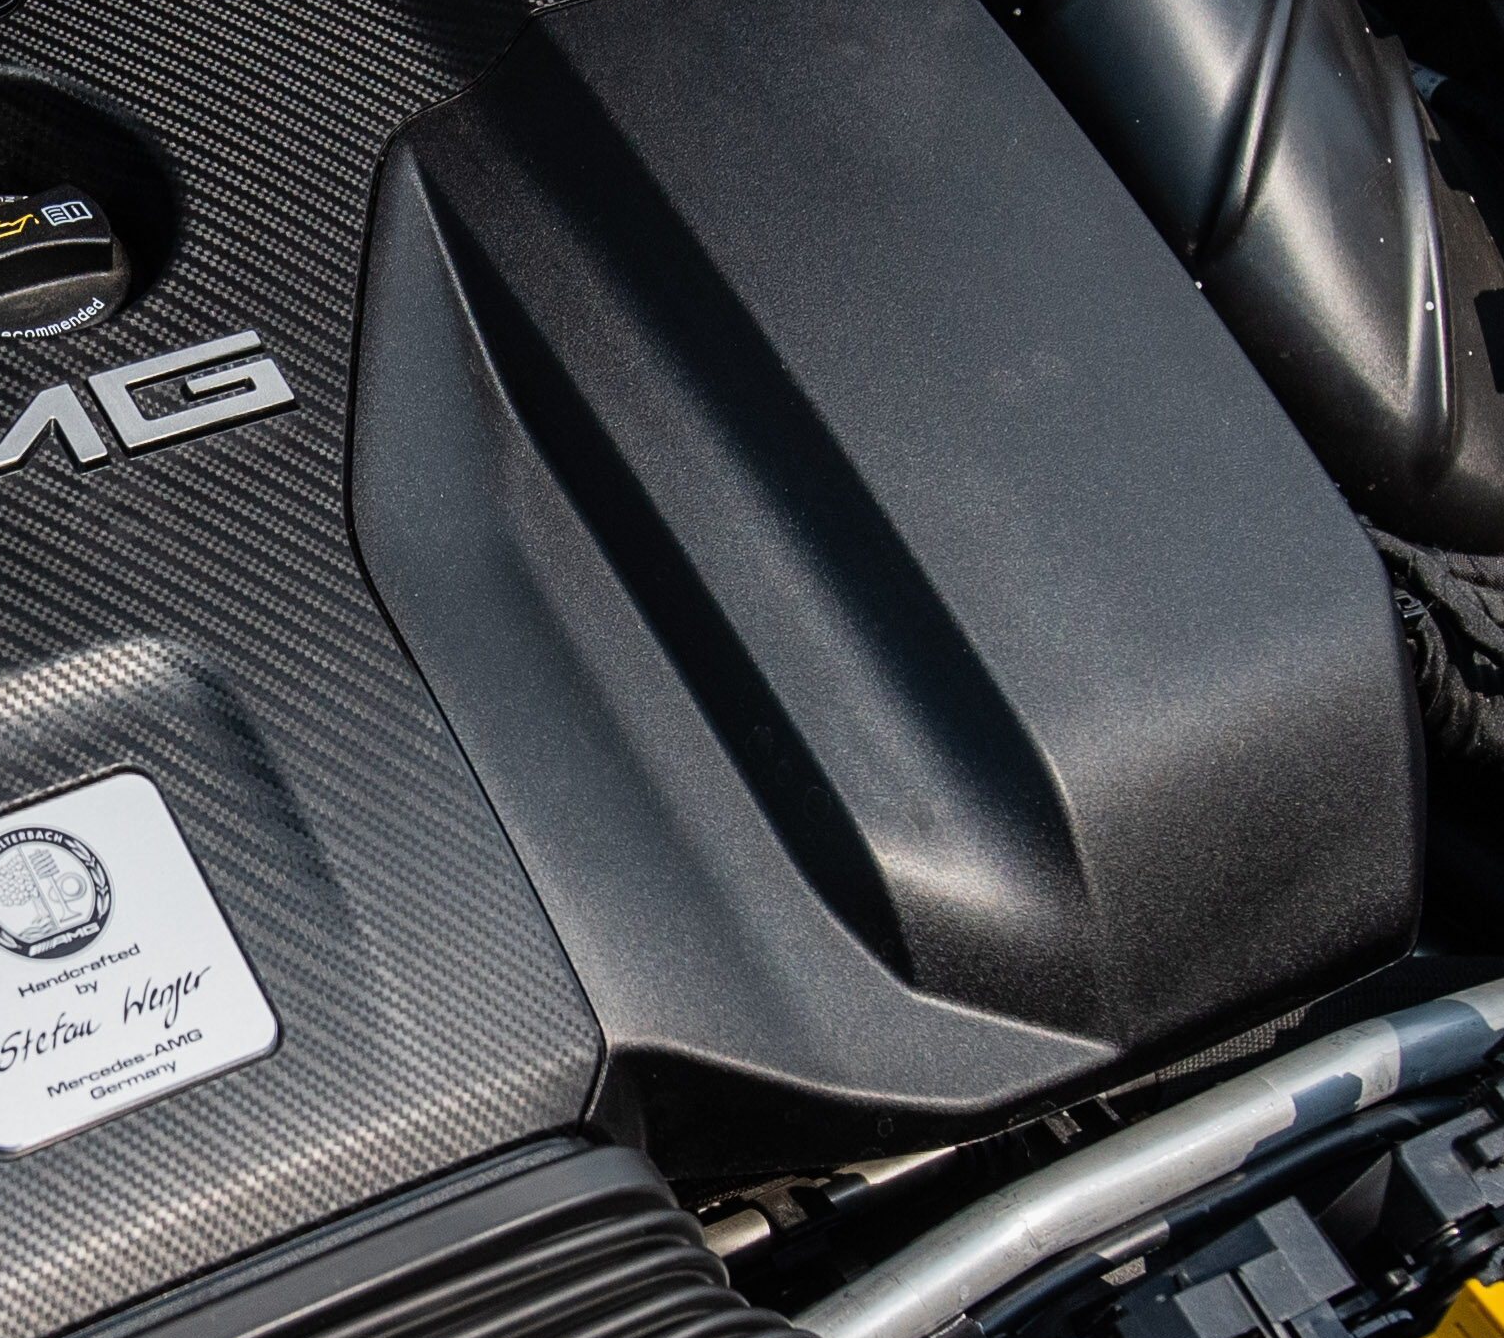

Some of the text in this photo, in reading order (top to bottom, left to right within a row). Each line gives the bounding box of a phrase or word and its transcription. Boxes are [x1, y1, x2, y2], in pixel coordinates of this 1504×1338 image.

[18, 943, 141, 998] Handcrafted
[75, 980, 99, 995] by
[46, 1027, 204, 1098] Mercedes-AMG
[89, 1059, 178, 1101] Germany
